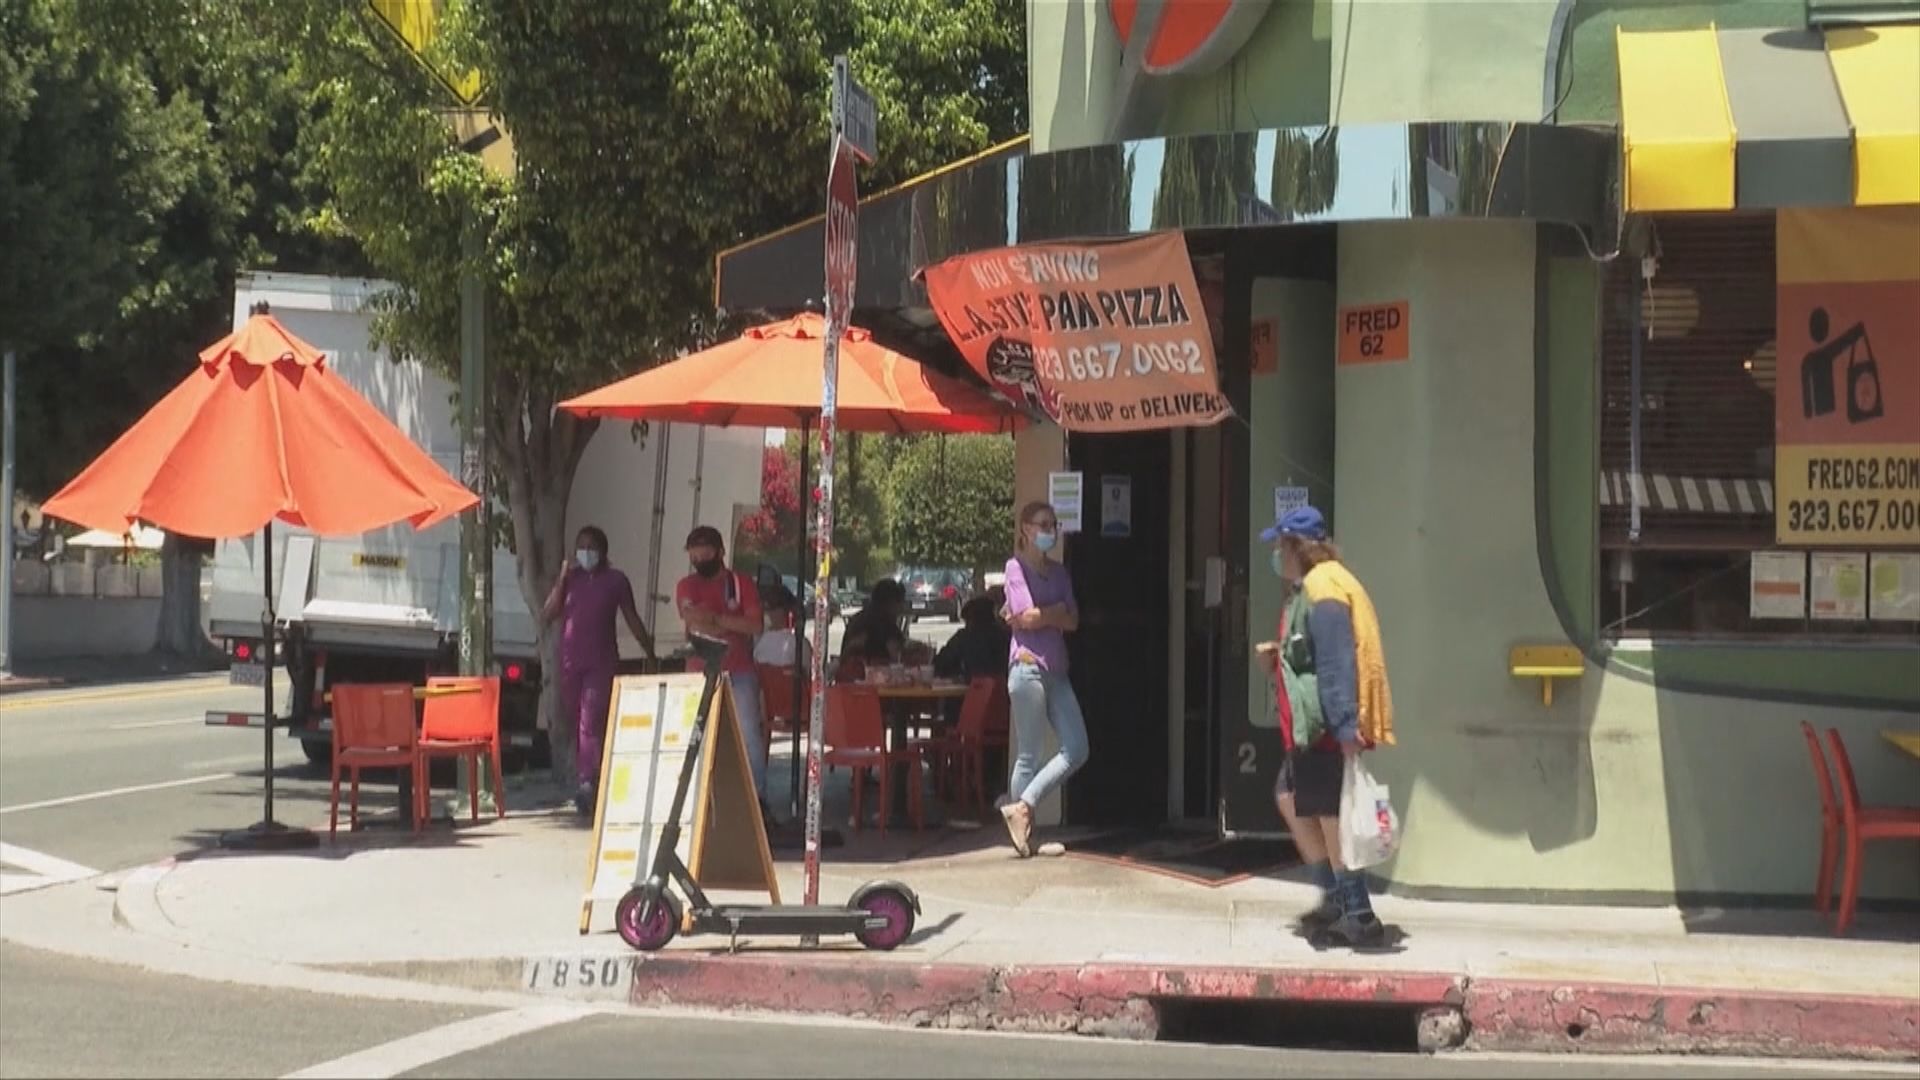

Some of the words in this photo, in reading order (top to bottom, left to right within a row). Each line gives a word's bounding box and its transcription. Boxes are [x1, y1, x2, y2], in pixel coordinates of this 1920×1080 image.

[828, 198, 856, 268] STOP
[1039, 287, 1098, 332] PAN
[1097, 282, 1190, 329] PIZZA
[1346, 307, 1401, 334] FRED
[1360, 334, 1384, 356] 62
[1064, 401, 1094, 423] PICK
[1095, 401, 1114, 420] UP
[1119, 403, 1137, 420] or
[1807, 457, 1919, 490] FRED62.COM
[1789, 499, 1919, 532] 323.667.00
[1238, 741, 1257, 773] 2
[529, 957, 619, 989] 1850
